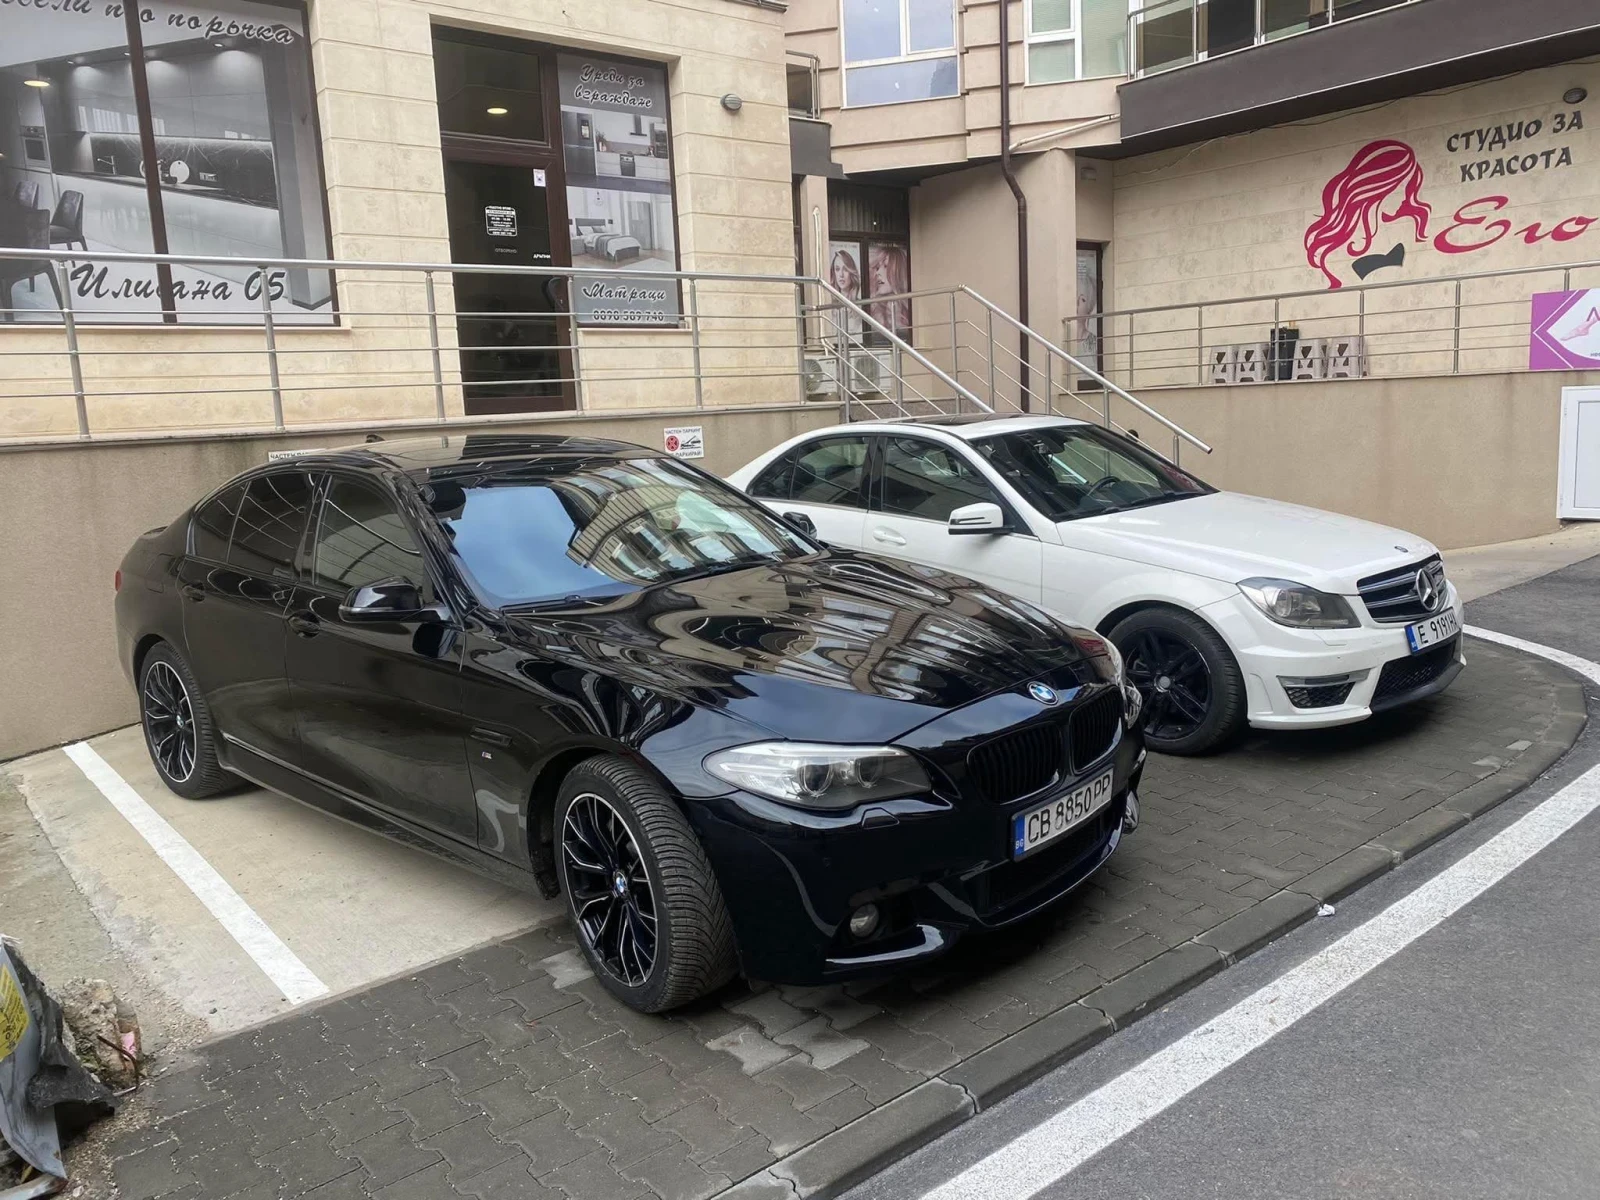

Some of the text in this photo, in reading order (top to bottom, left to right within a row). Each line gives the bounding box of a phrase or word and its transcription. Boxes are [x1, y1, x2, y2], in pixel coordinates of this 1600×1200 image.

[580, 64, 644, 89] Уреди за
[574, 84, 652, 107] вграждане
[1446, 110, 1584, 153] СТУДИО ЗА
[1460, 146, 1573, 182] КРАСОТА
[243, 270, 286, 301] 05
[582, 282, 666, 302] Матраци
[1417, 624, 1429, 644] E
[1028, 808, 1051, 843] CB
[1054, 786, 1092, 830] 8850
